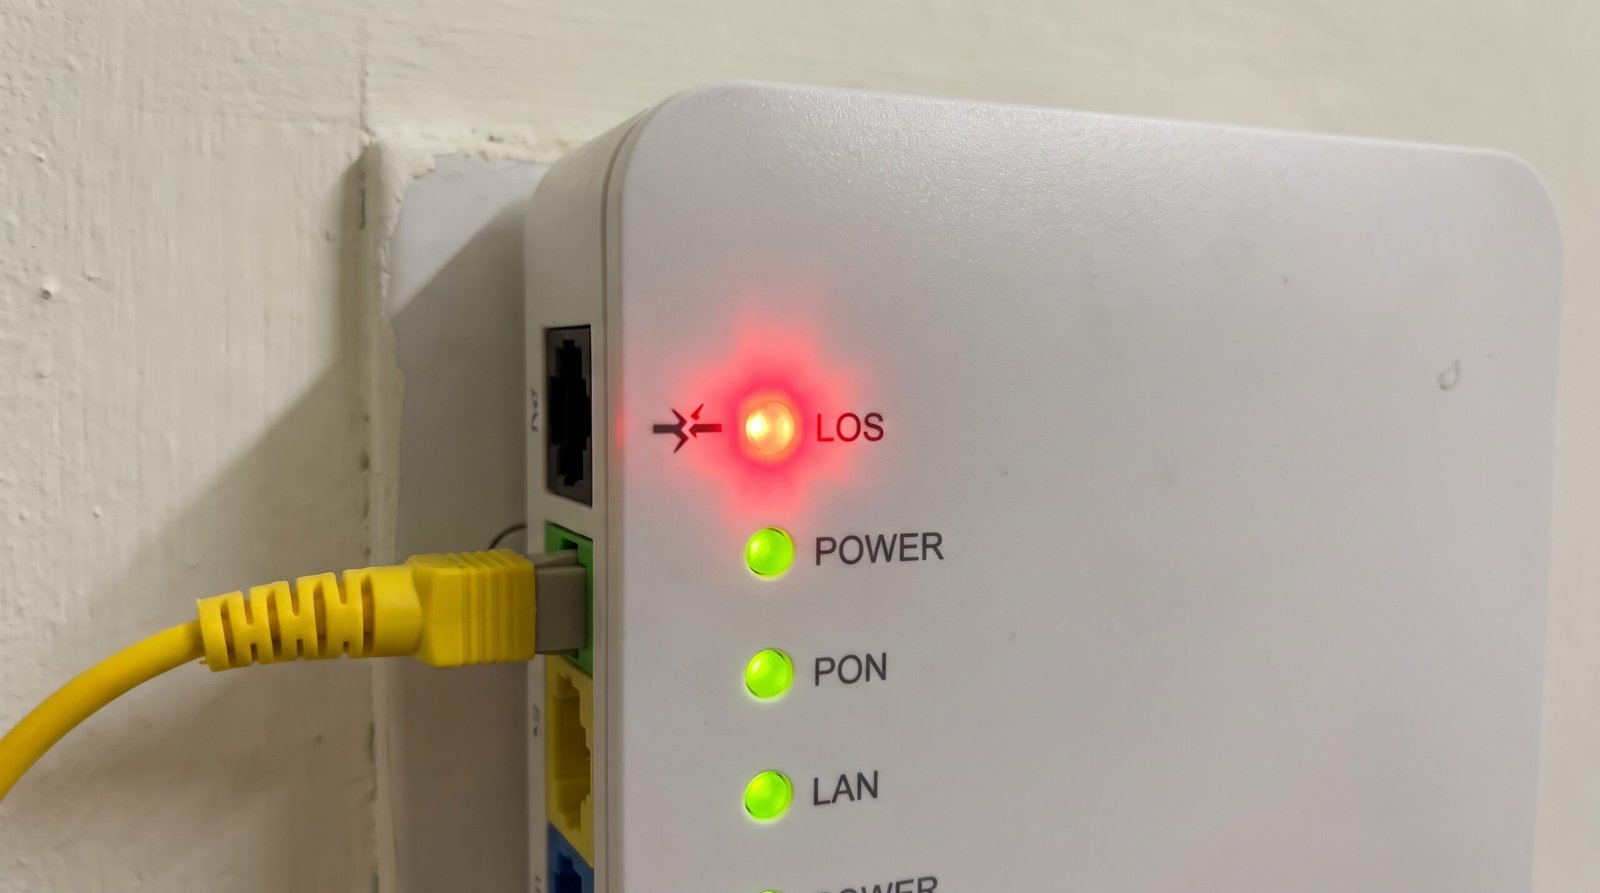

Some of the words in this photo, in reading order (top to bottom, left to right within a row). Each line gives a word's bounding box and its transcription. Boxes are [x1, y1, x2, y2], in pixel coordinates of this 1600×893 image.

[816, 412, 885, 442] LOS
[815, 532, 944, 566] POWER
[814, 652, 887, 687] PON
[813, 770, 879, 806] LAN
